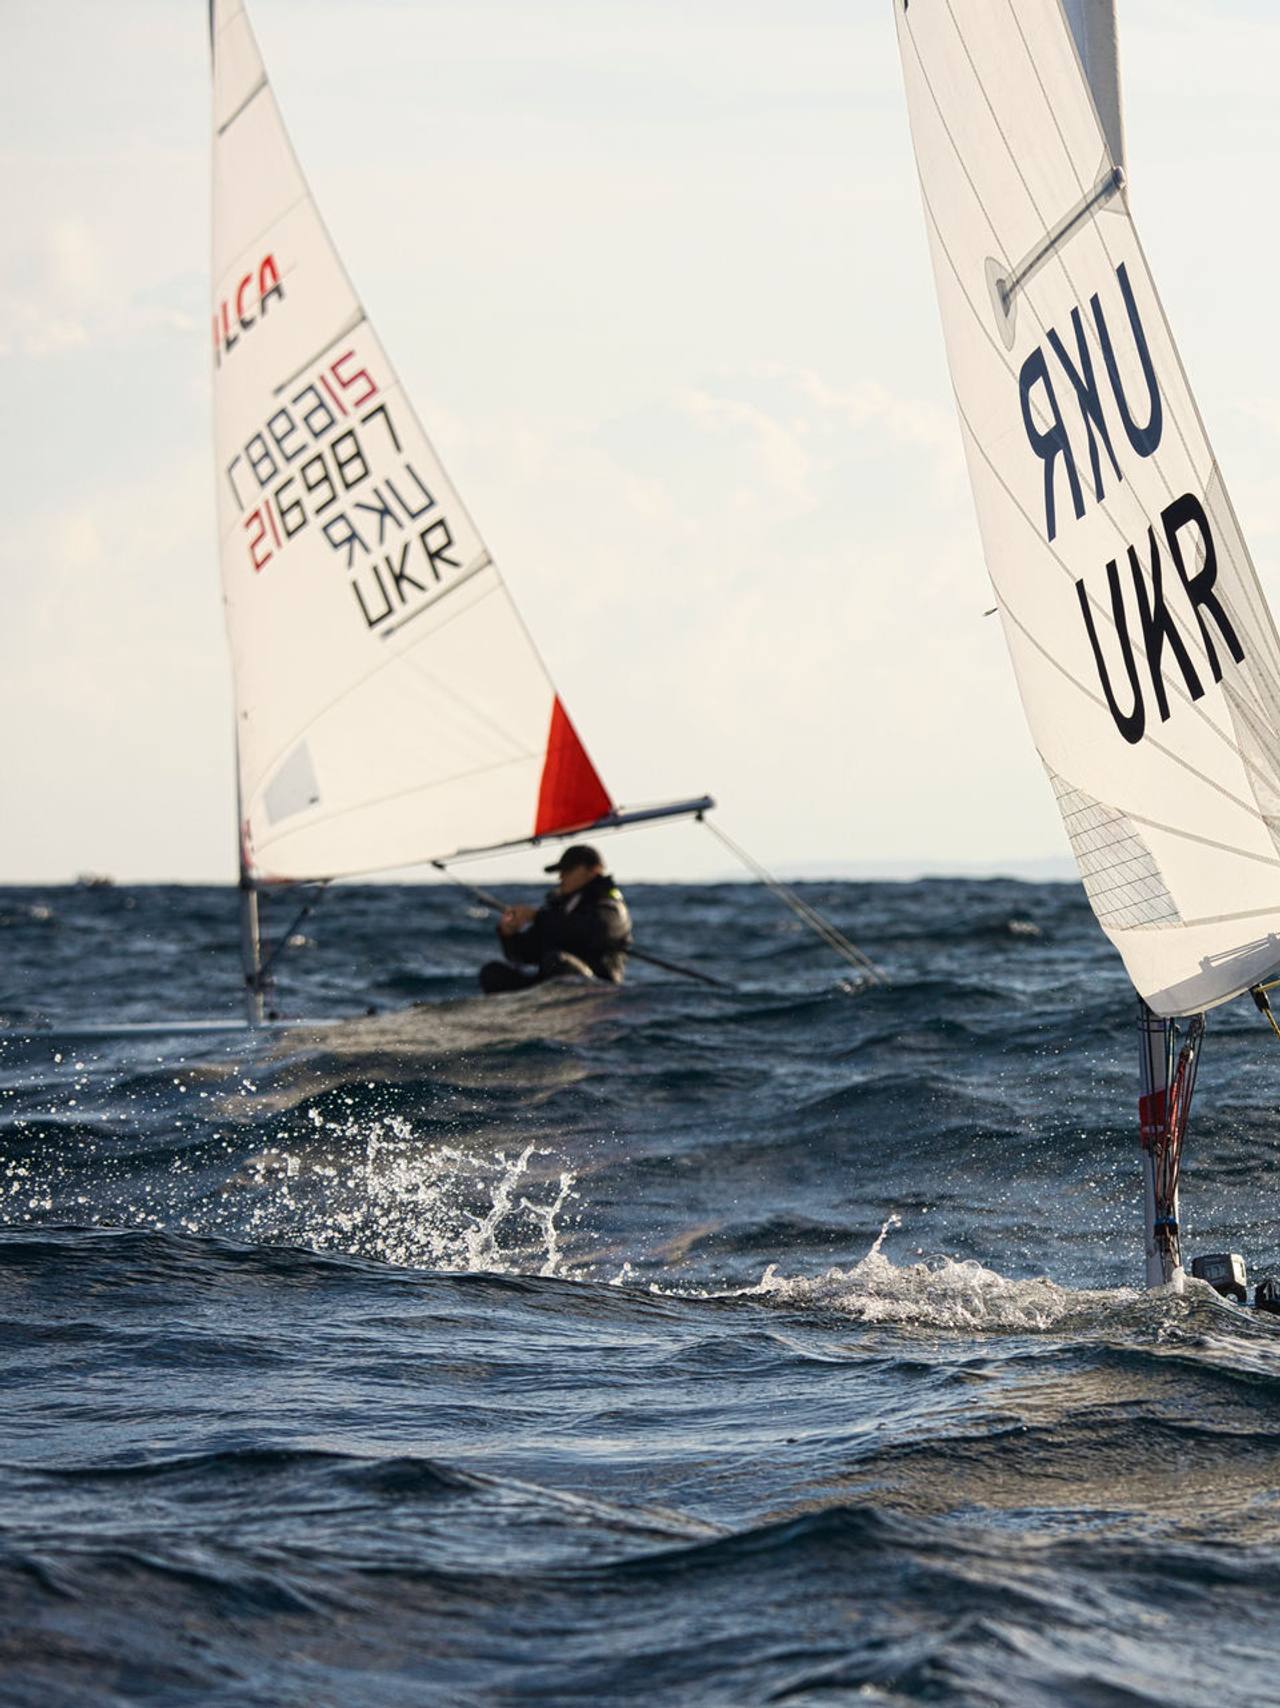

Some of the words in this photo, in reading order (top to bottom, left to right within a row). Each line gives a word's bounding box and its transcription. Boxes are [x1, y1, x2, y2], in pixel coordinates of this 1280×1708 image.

[212, 254, 284, 369] ILCA
[244, 404, 402, 572] 216987
[352, 518, 462, 627] UKR
[1075, 493, 1245, 744] UKR
